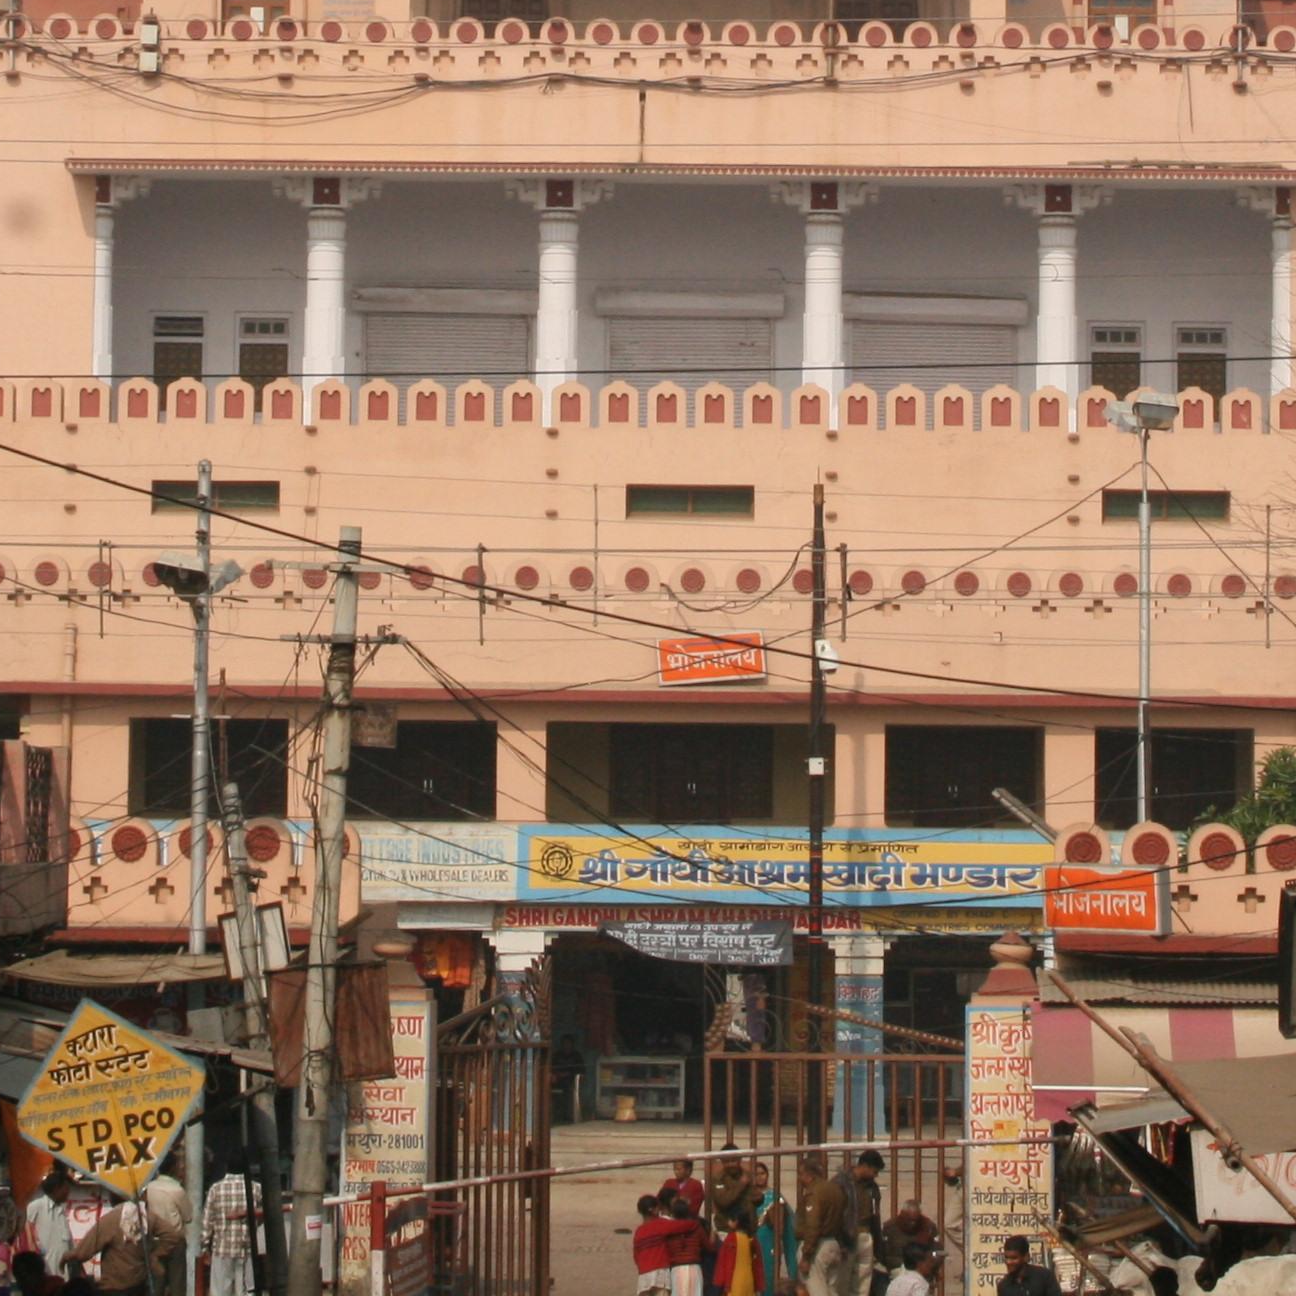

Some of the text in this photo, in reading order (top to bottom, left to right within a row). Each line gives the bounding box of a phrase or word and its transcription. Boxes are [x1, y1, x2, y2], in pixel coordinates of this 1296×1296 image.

[667, 644, 757, 671] भोजनालय
[409, 869, 468, 882] WHOLESALE
[471, 869, 508, 882] DEALERS
[578, 849, 623, 885] श्री
[909, 864, 1041, 891] भण्डार
[1052, 875, 1147, 917] भोजनालय
[505, 907, 549, 928] SHRI
[554, 907, 621, 928] GANDHI
[678, 934, 700, 947] पर
[65, 1024, 117, 1057] कटारा
[48, 1045, 151, 1087] फोटो स्टेट
[363, 1081, 406, 1102] सेवा
[47, 1107, 175, 1152] STD PCO
[86, 1137, 158, 1174] FAX
[979, 1160, 1044, 1185] मथुरा
